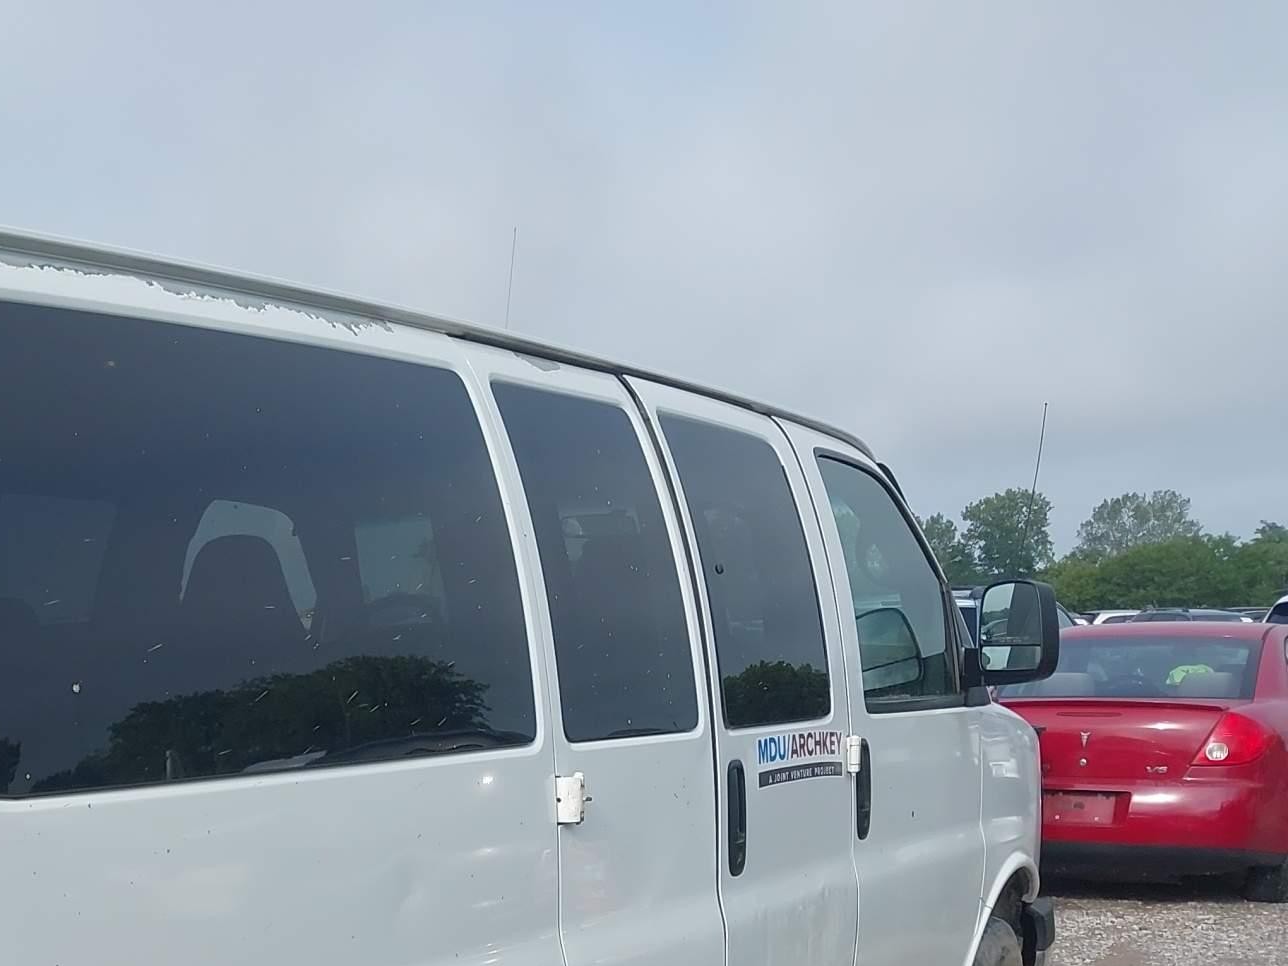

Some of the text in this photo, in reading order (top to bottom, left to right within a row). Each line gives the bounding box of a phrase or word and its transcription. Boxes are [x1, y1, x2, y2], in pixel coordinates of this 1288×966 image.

[758, 731, 842, 764] MDU/ARCHKEY
[774, 771, 789, 782] JOINT
[791, 768, 812, 779] VENTURE
[814, 766, 835, 775] PROJECT
